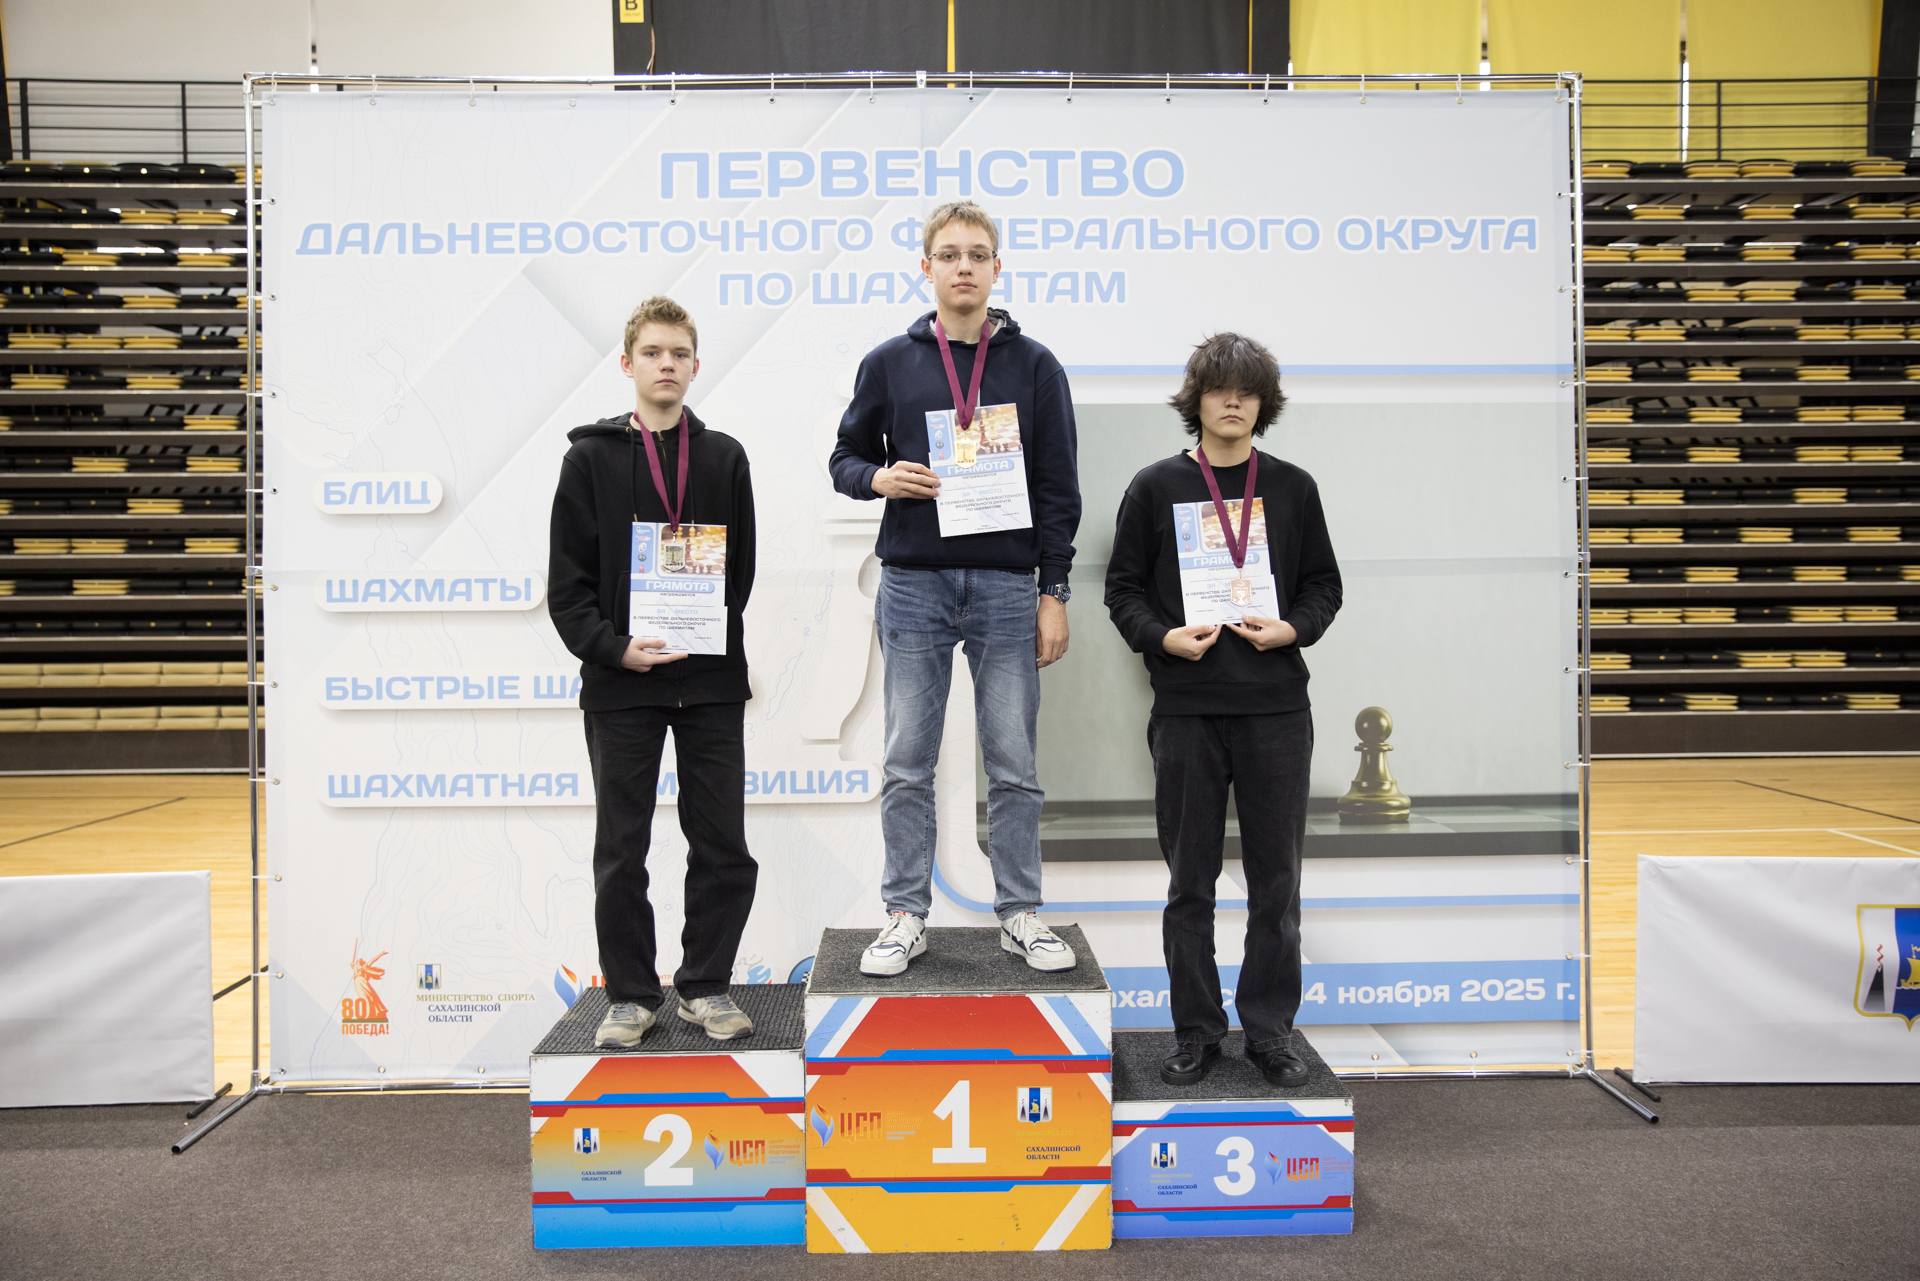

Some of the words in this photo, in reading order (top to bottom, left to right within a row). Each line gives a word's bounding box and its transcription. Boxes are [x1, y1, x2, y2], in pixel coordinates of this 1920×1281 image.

[660, 149, 1185, 200] ПЕРВЕНСТВО
[296, 217, 874, 256] ДАЛЬНЕВОСТОЧНОГО
[891, 217, 1320, 253] ФЕРАЛЬНОГО
[1337, 217, 1538, 251] ОКРУГА
[719, 271, 793, 307] ПО
[812, 270, 1127, 306] ШАХАТАМ
[323, 480, 432, 506] БЛИЦ
[1193, 553, 1255, 567] ГРАМА
[325, 577, 532, 603] ШАХМАТЫ
[646, 581, 710, 592] ГРАМОТА
[325, 675, 521, 701] БЫСТРЫЕ
[328, 773, 580, 799] ШАХМАТНАЯ
[416, 993, 493, 1002] МИНИСТЕРСТВО
[497, 993, 536, 1002] СПОРТА
[1338, 980, 1450, 1008] ноября
[1460, 978, 1546, 1003] 2025
[1556, 982, 1576, 1001] г.
[428, 1003, 502, 1013] САХАЛИНСКОЙ
[428, 1015, 473, 1024] ОБЛАСТИ
[341, 1023, 390, 1036] ПОБЕДА!
[840, 1112, 881, 1142] ЦСП
[932, 1080, 986, 1164] 1
[643, 1113, 694, 1187] 2
[729, 1140, 766, 1168] ЦСП
[1026, 1145, 1081, 1153] САХАЛИНСКОЙ
[1213, 1136, 1256, 1196] 3
[1286, 1157, 1320, 1183] ЦСП
